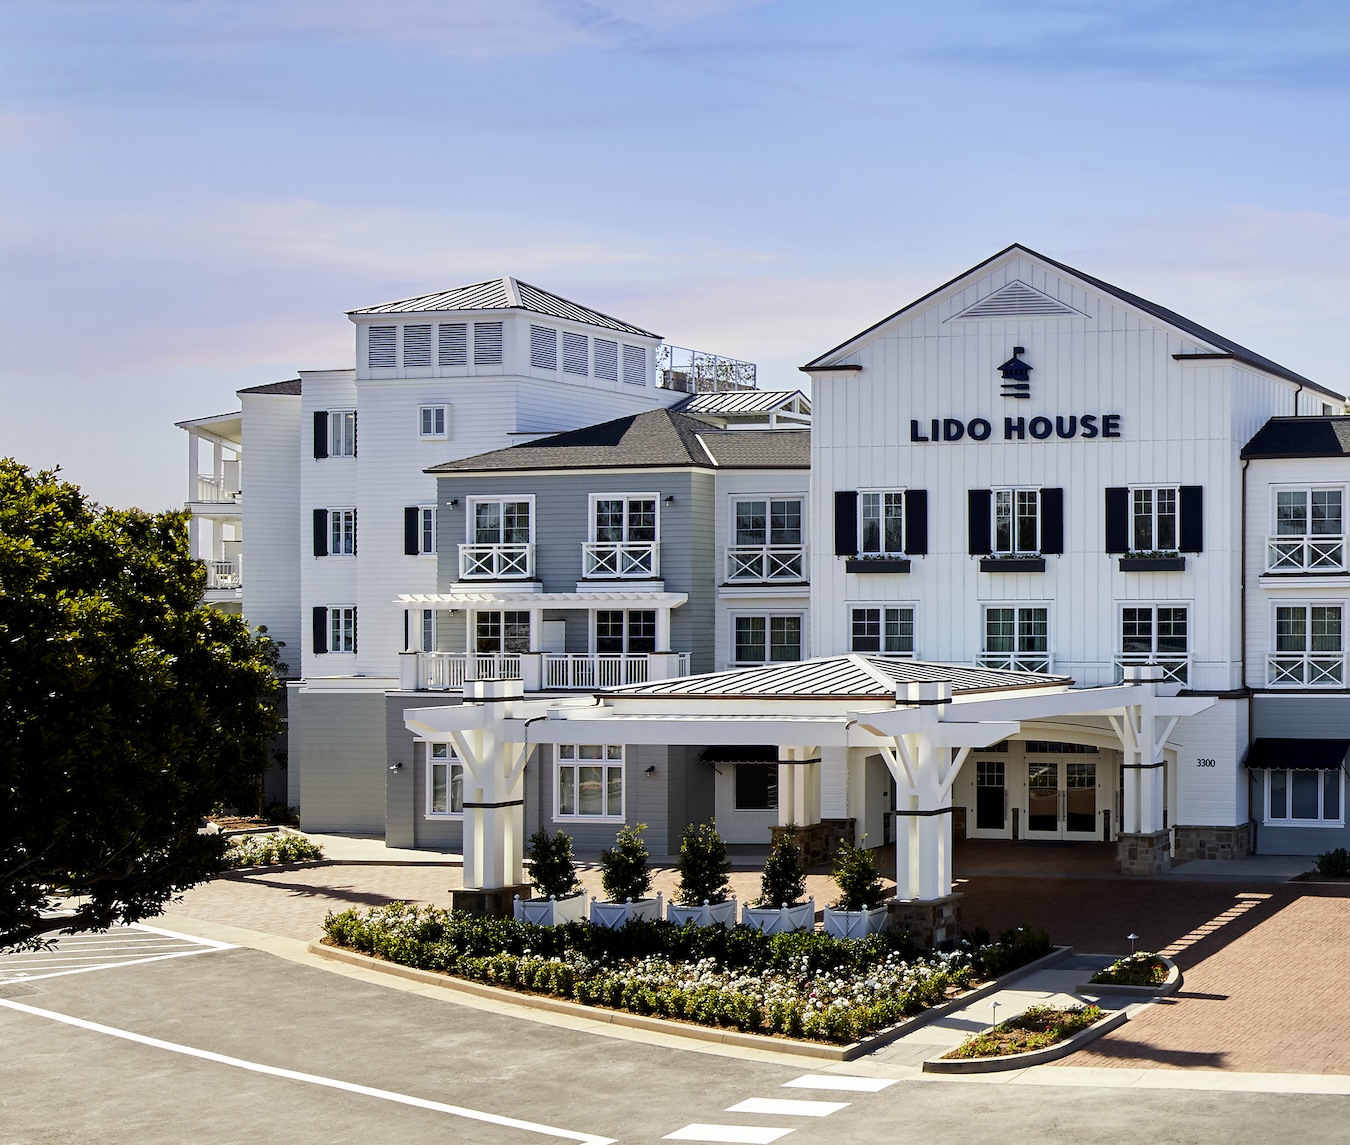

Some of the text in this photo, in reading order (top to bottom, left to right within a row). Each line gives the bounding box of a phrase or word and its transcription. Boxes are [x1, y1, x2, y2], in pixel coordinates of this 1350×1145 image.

[910, 414, 1121, 442] LIDO HOUSE
[1196, 758, 1216, 768] 3300
